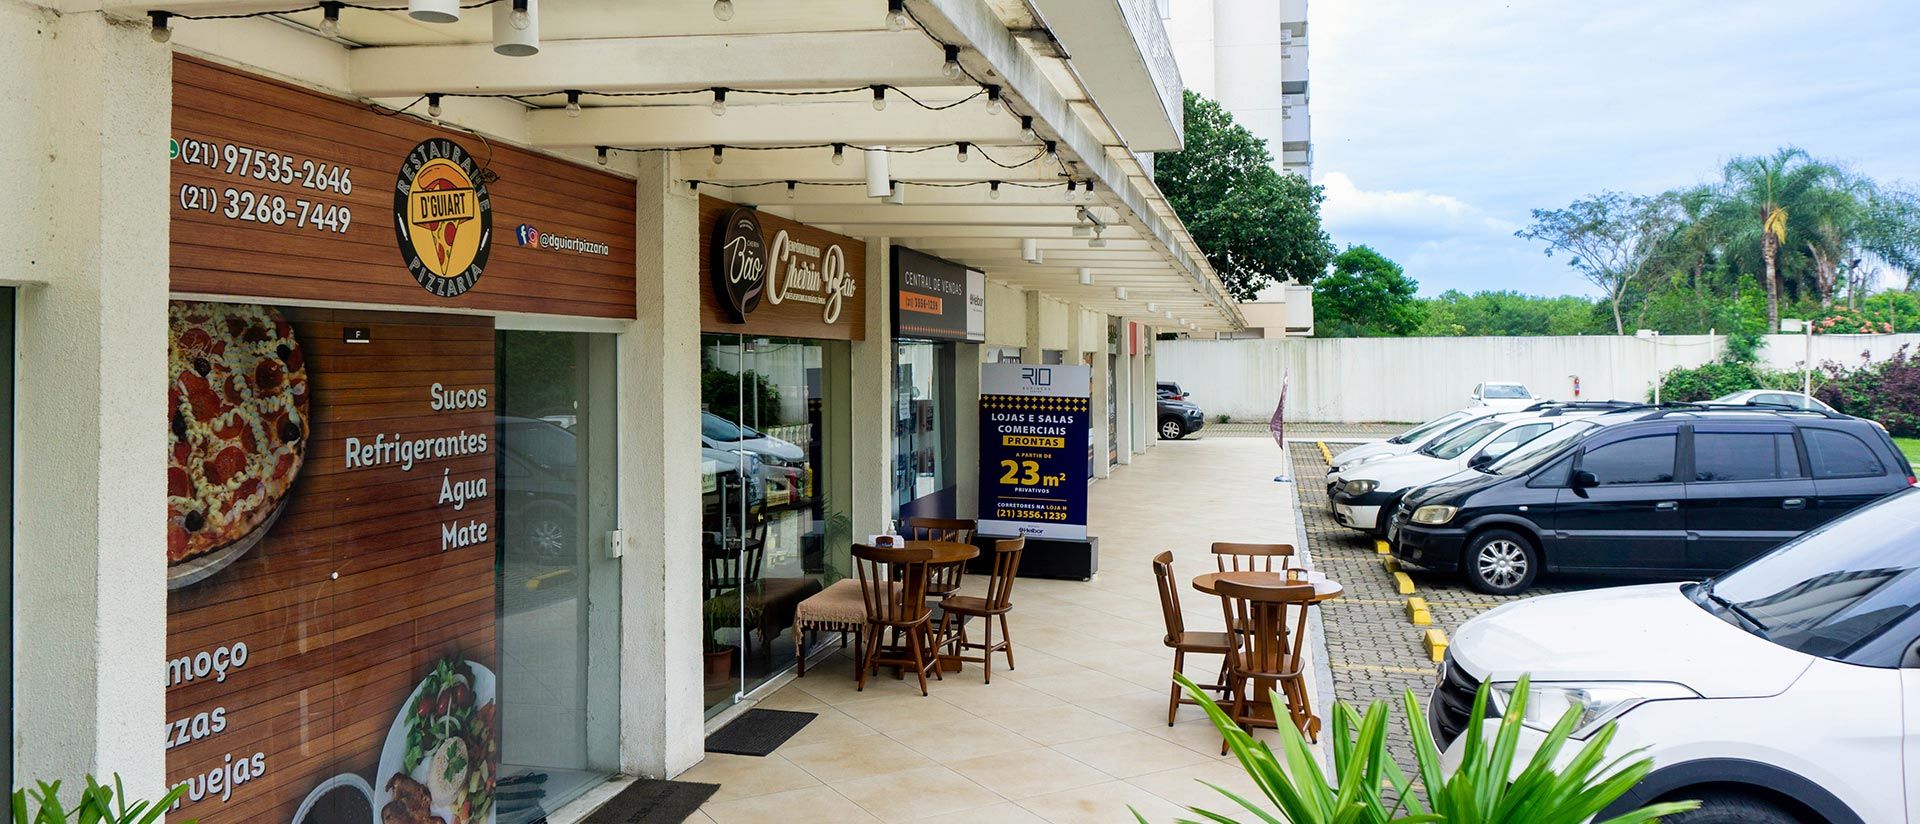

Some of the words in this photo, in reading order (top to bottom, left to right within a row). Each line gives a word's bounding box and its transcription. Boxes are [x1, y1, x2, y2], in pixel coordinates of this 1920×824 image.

[181, 139, 218, 168] (21)
[224, 144, 351, 195] 97535-2646
[396, 140, 490, 213] RESTAURANTE
[180, 184, 217, 213] (21)
[224, 188, 351, 233] 3268-7449
[420, 193, 466, 220] D'GUIART
[540, 233, 609, 255] @dguiartpizzaria
[408, 255, 483, 298] PIZZARIA
[904, 271, 932, 290] CENTRAL
[933, 277, 941, 292] DE
[942, 280, 962, 296] VENDAS
[355, 330, 361, 339] F
[1022, 367, 1051, 386] RIO
[430, 382, 488, 411] Sucos
[991, 412, 1025, 423] LOJAS
[1028, 414, 1035, 422] E
[1038, 414, 1074, 424] SALAS
[997, 424, 1067, 436] COMERCIAIS
[345, 430, 488, 471] Refrigerantes
[1007, 437, 1059, 447] PRONTAS
[999, 459, 1040, 486] 23
[438, 467, 488, 511] Água
[1014, 486, 1050, 494] PRIVATIVOS
[996, 508, 1015, 519] (21)
[1016, 509, 1067, 521] 3556.1239
[441, 519, 488, 551] Mate
